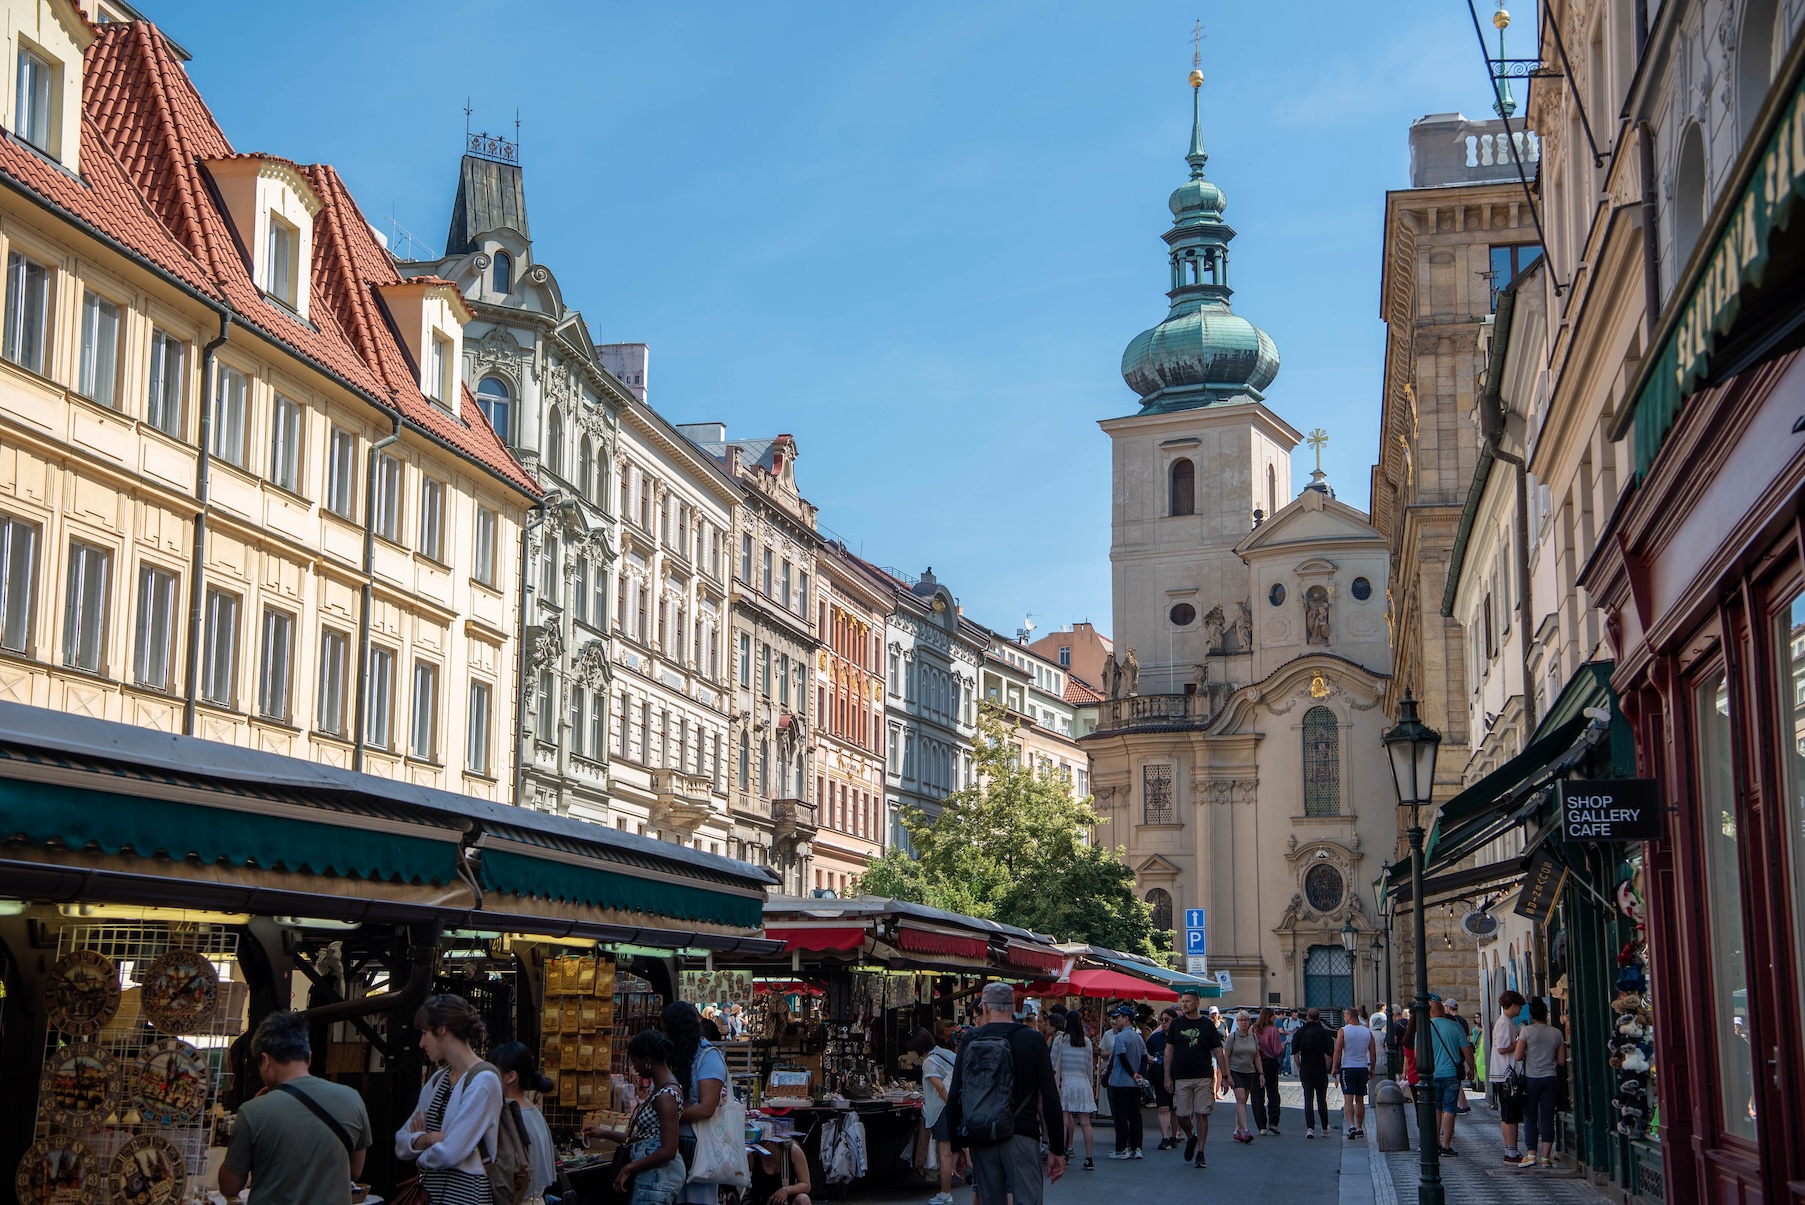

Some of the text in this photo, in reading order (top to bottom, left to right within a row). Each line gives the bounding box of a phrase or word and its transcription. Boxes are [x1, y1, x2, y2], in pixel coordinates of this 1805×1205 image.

[1567, 795, 1613, 809] SHOP
[1568, 809, 1640, 823] GALLERY
[1569, 823, 1612, 837] CAFE
[1190, 931, 1201, 948] P
